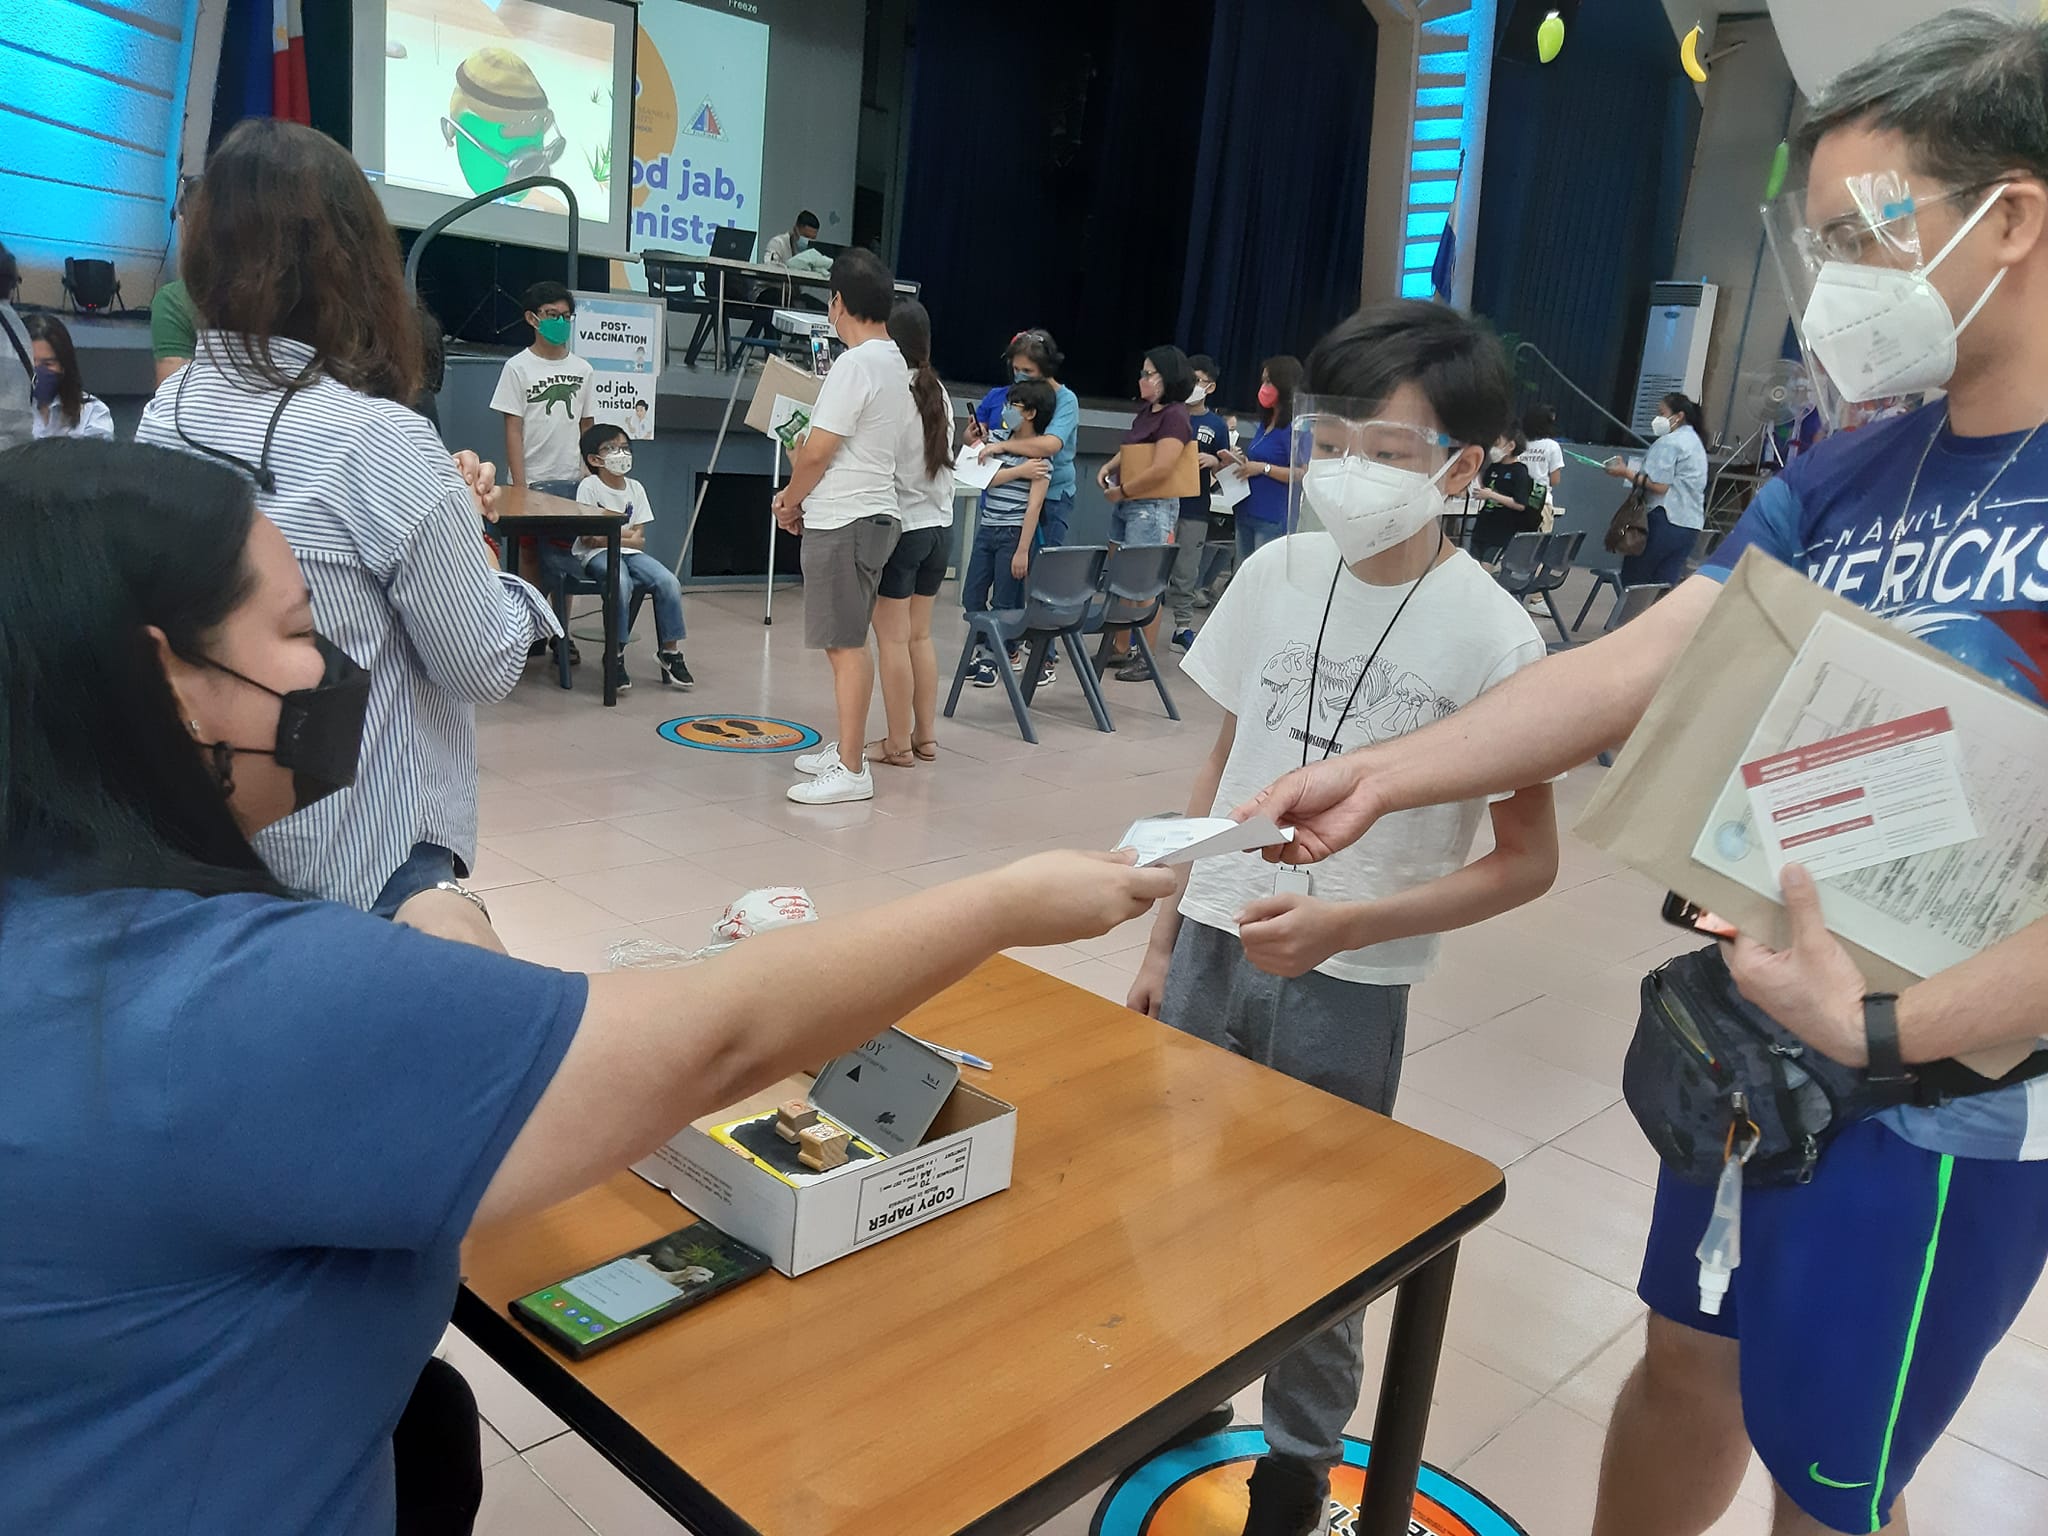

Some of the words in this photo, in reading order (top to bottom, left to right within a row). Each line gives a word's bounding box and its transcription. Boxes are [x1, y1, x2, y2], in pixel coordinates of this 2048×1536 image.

[677, 158, 745, 209] jab,
[600, 321, 631, 332] POST-
[579, 331, 647, 345] VACCINATION
[526, 374, 584, 398] CARNIVORE
[614, 380, 638, 397] jab,
[919, 1168, 932, 1179] A4
[919, 1177, 931, 1188] 70
[888, 1193, 916, 1209] Indonesia
[917, 1186, 955, 1213] COPY
[868, 1202, 914, 1232] PAPER
